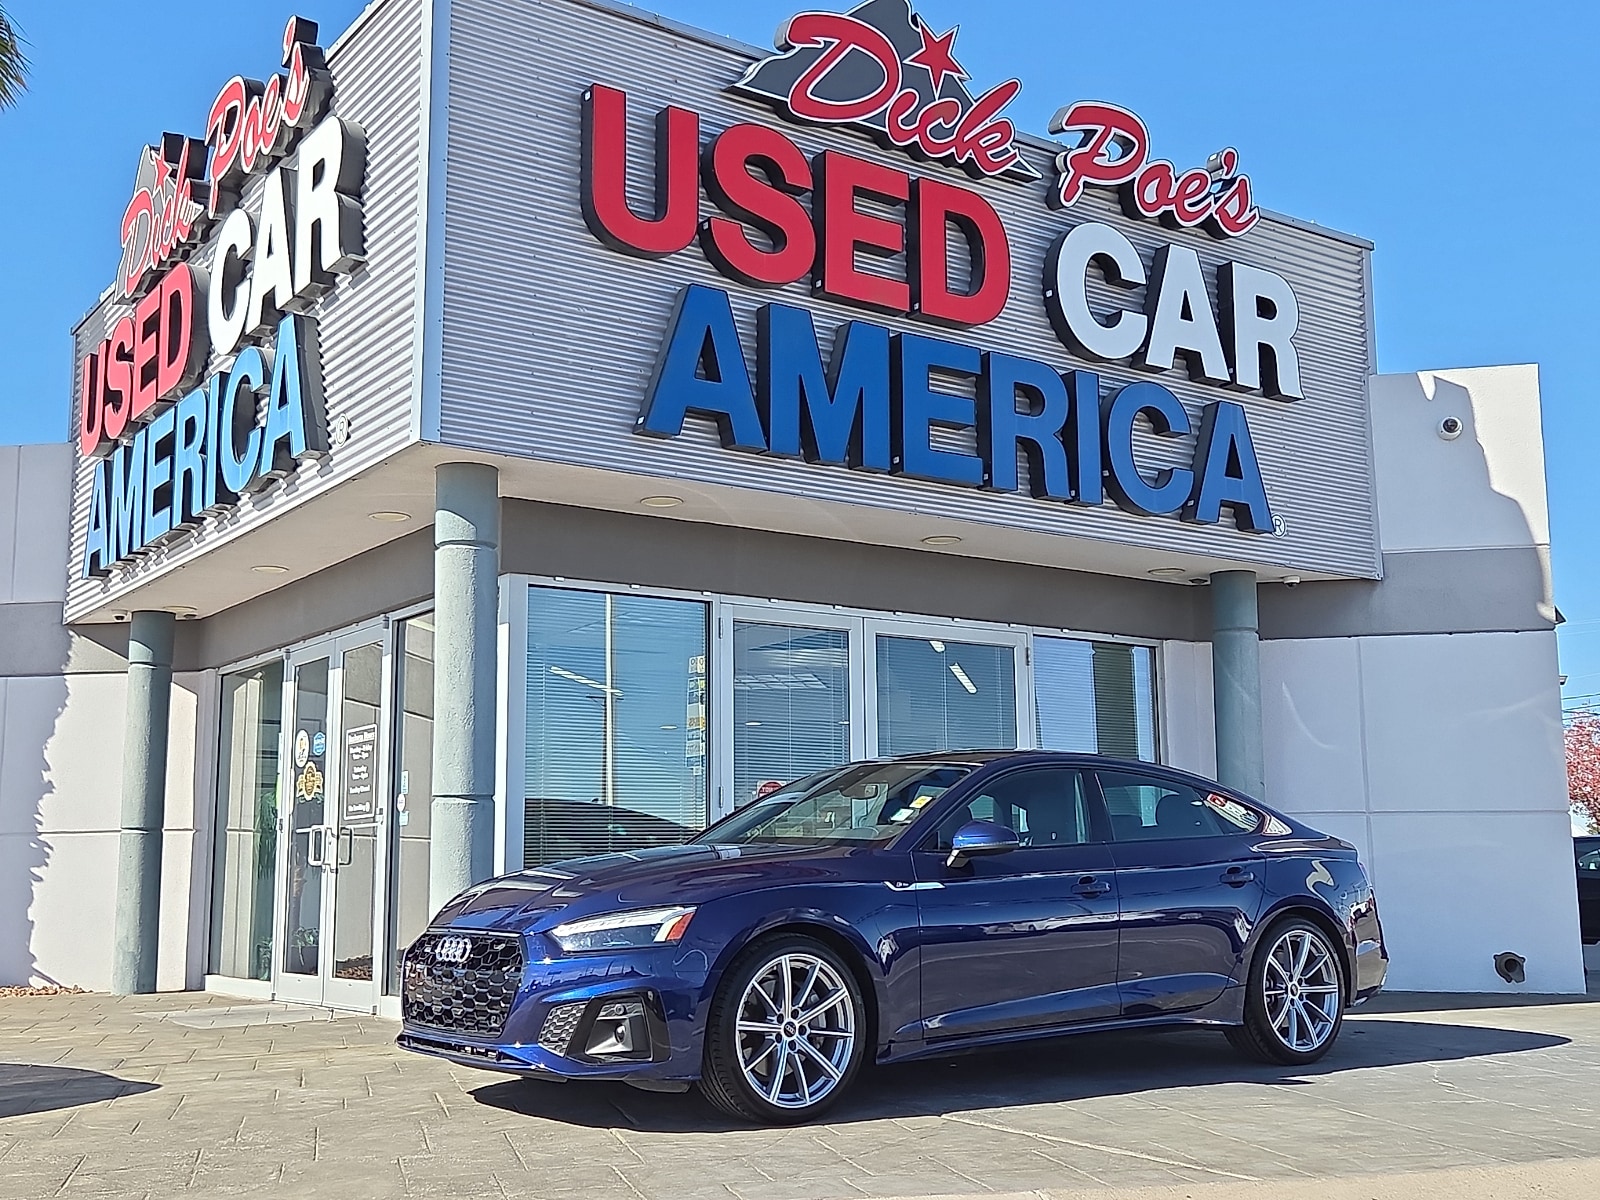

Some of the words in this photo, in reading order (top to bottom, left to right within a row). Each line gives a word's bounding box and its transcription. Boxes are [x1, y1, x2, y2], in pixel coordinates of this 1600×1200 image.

[121, 136, 196, 298] Dick
[206, 15, 307, 220] Poe's
[587, 83, 1012, 327] USED
[1055, 222, 1304, 400] CAR
[785, 12, 1023, 179] Dick
[1056, 101, 1260, 237] Poe's
[80, 262, 196, 456] USED
[208, 115, 345, 356] CAR
[637, 284, 1275, 534] AMERICA
[82, 314, 307, 579] AMERICA
